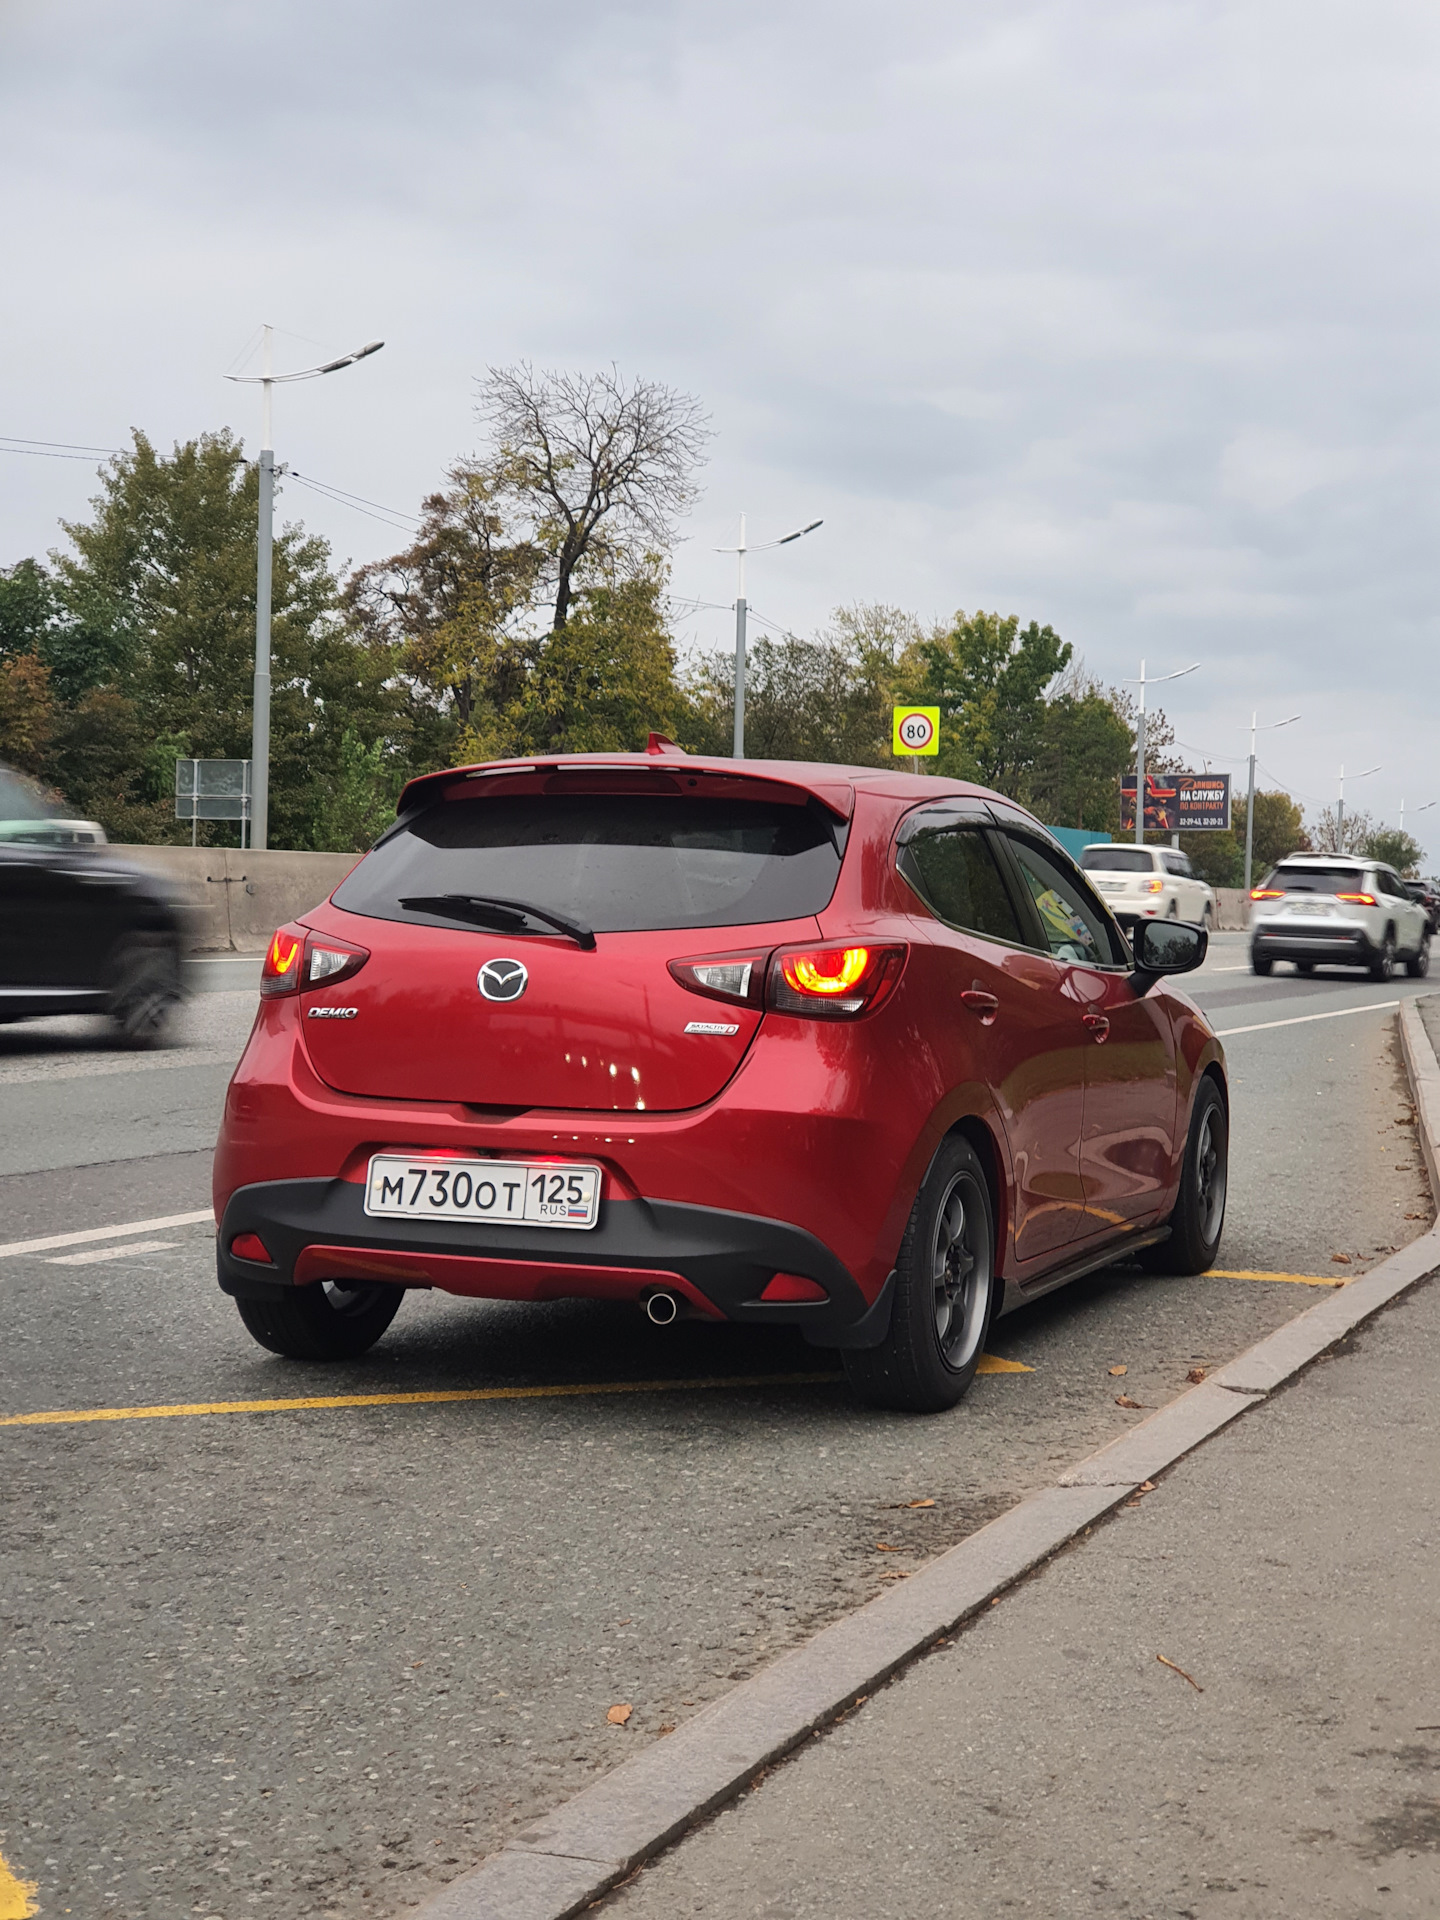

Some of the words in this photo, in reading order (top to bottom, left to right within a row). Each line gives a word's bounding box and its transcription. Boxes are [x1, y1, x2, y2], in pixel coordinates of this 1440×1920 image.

[907, 724, 926, 739] 80
[1180, 790, 1191, 801] НА
[1192, 790, 1225, 801] СЛУЖБУ
[1180, 801, 1189, 810] ПО
[1190, 801, 1224, 810] КОНТРАКТУ
[308, 1007, 358, 1019] DEMIO
[531, 1174, 584, 1205] 125
[540, 1203, 567, 1216] RUS
